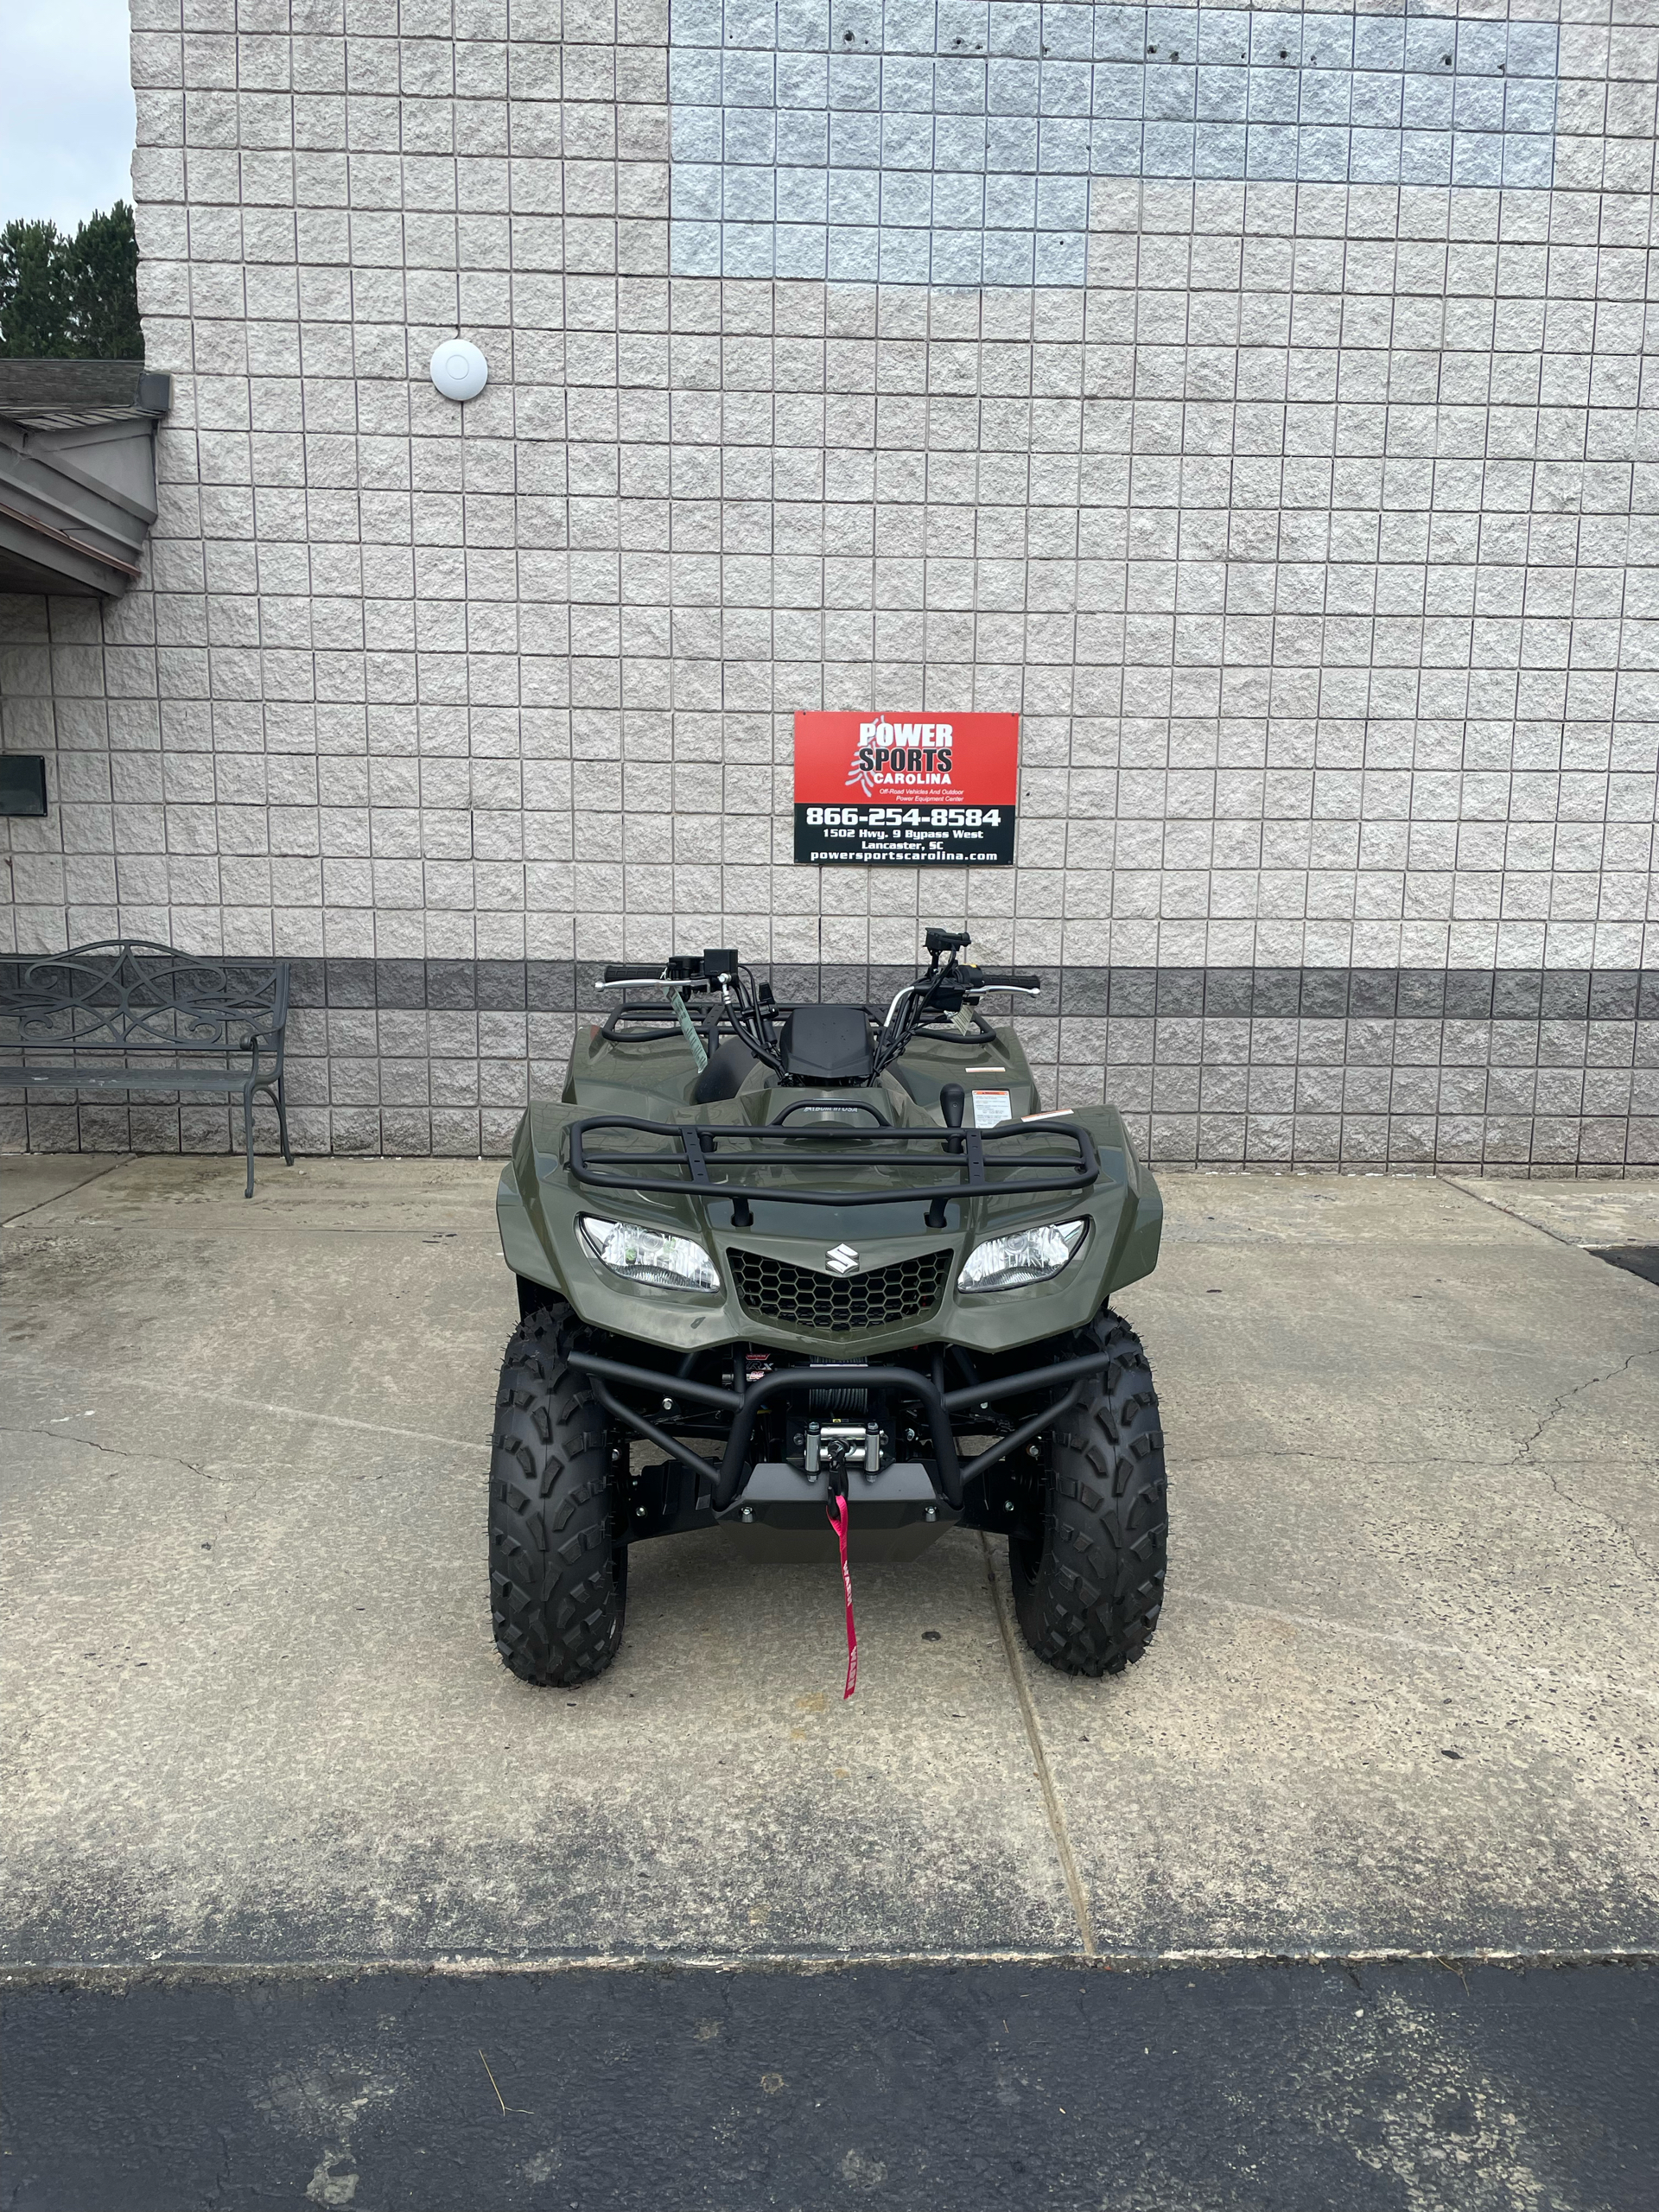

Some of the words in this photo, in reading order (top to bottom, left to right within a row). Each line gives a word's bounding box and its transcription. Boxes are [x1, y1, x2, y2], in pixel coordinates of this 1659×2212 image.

[860, 723, 952, 747] POWER
[859, 747, 952, 772] SPORTS
[874, 773, 951, 785] CAROLINA
[806, 807, 1001, 826] 866-254-8584
[823, 829, 855, 837] 1502
[859, 829, 888, 839] Hwy.
[905, 830, 949, 840] Bypass
[952, 830, 983, 838] West
[861, 841, 925, 851] Lancaster,
[810, 851, 997, 861] powersportscarolina.com
